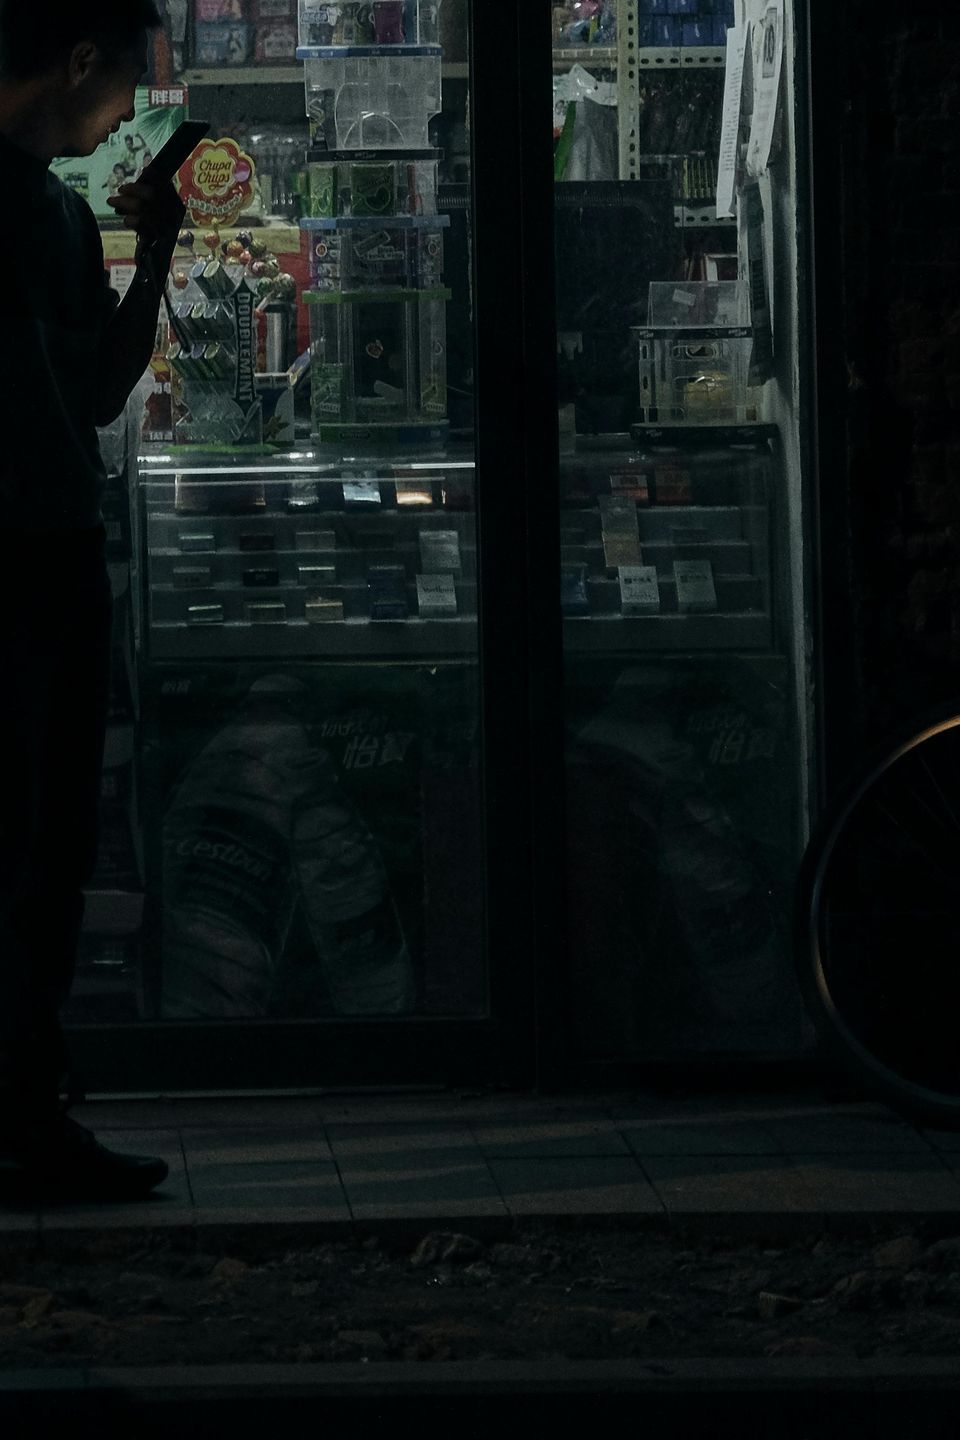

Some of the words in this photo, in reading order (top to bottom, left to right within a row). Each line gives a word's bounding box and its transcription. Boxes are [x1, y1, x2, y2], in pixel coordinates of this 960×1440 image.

[199, 158, 232, 173] Chupa
[197, 171, 231, 189] Chups
[237, 292, 253, 401] DOUBLEMINT
